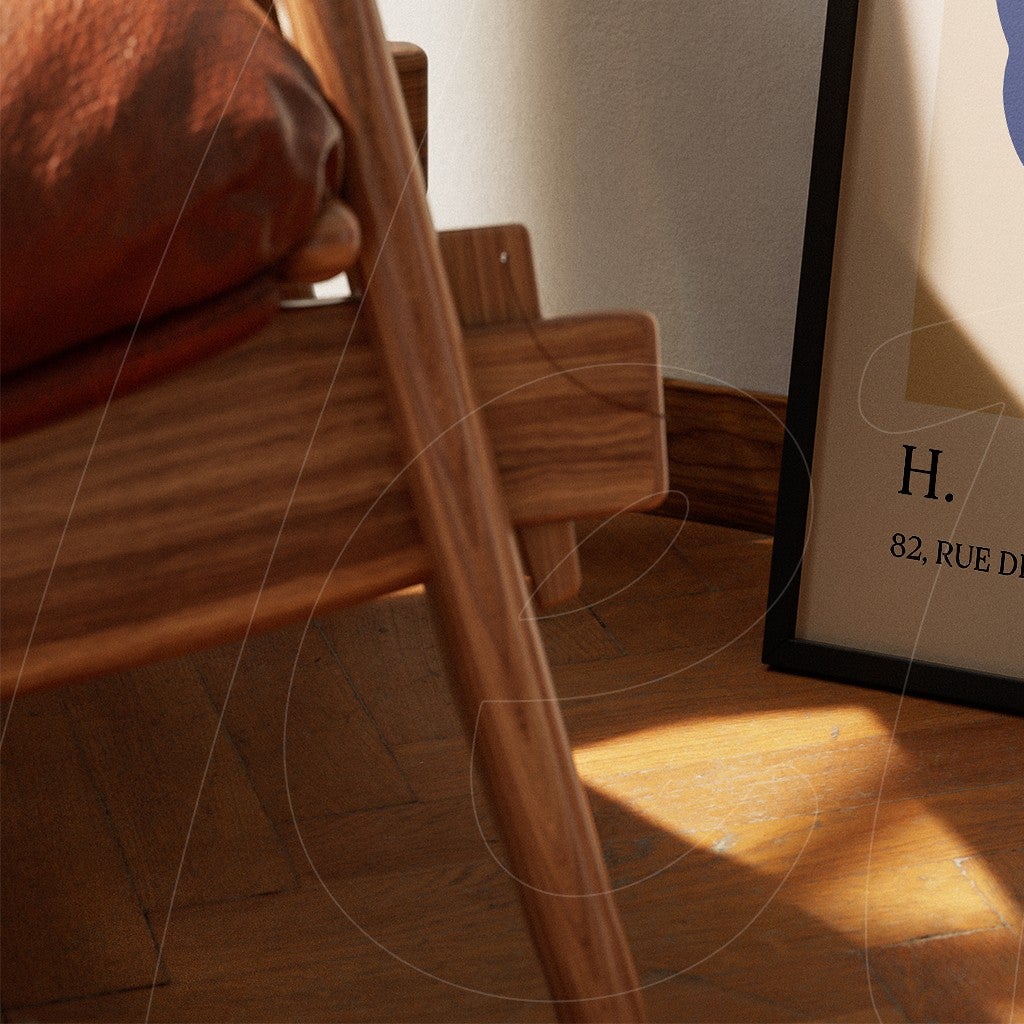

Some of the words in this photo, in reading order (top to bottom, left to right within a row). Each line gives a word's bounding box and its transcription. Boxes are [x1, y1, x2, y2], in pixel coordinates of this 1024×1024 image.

[897, 444, 954, 503] H.
[889, 532, 928, 566] 82,
[935, 539, 991, 573] RUE
